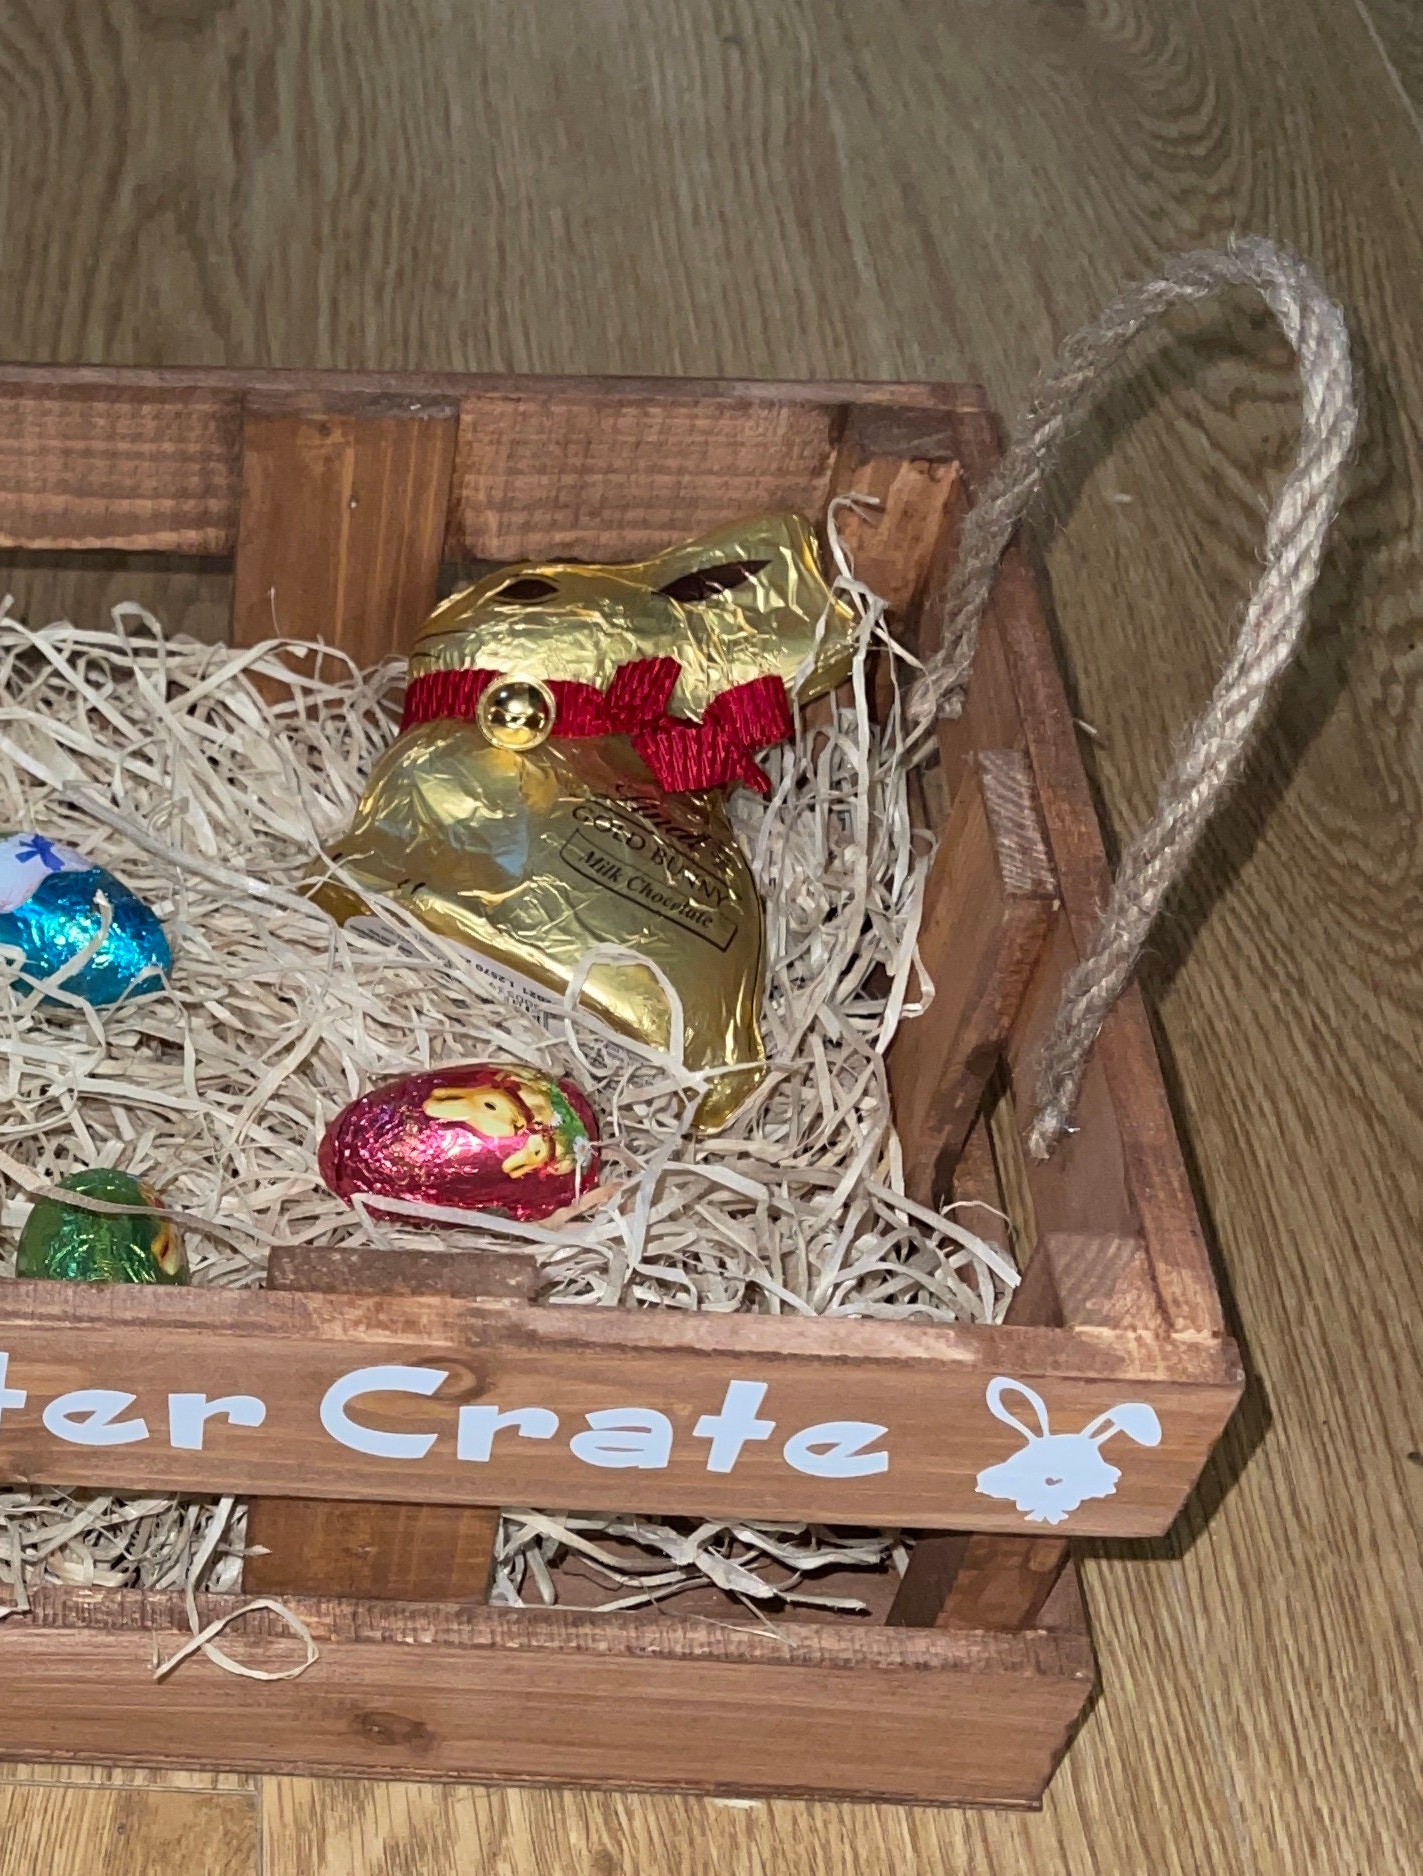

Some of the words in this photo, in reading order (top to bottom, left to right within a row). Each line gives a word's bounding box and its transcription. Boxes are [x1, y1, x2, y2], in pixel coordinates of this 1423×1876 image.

[572, 805, 646, 850] GOLD
[651, 847, 729, 906] BUNNY
[579, 850, 623, 883] Milk
[627, 875, 713, 928] Chocolate
[320, 1365, 889, 1478] Crate
